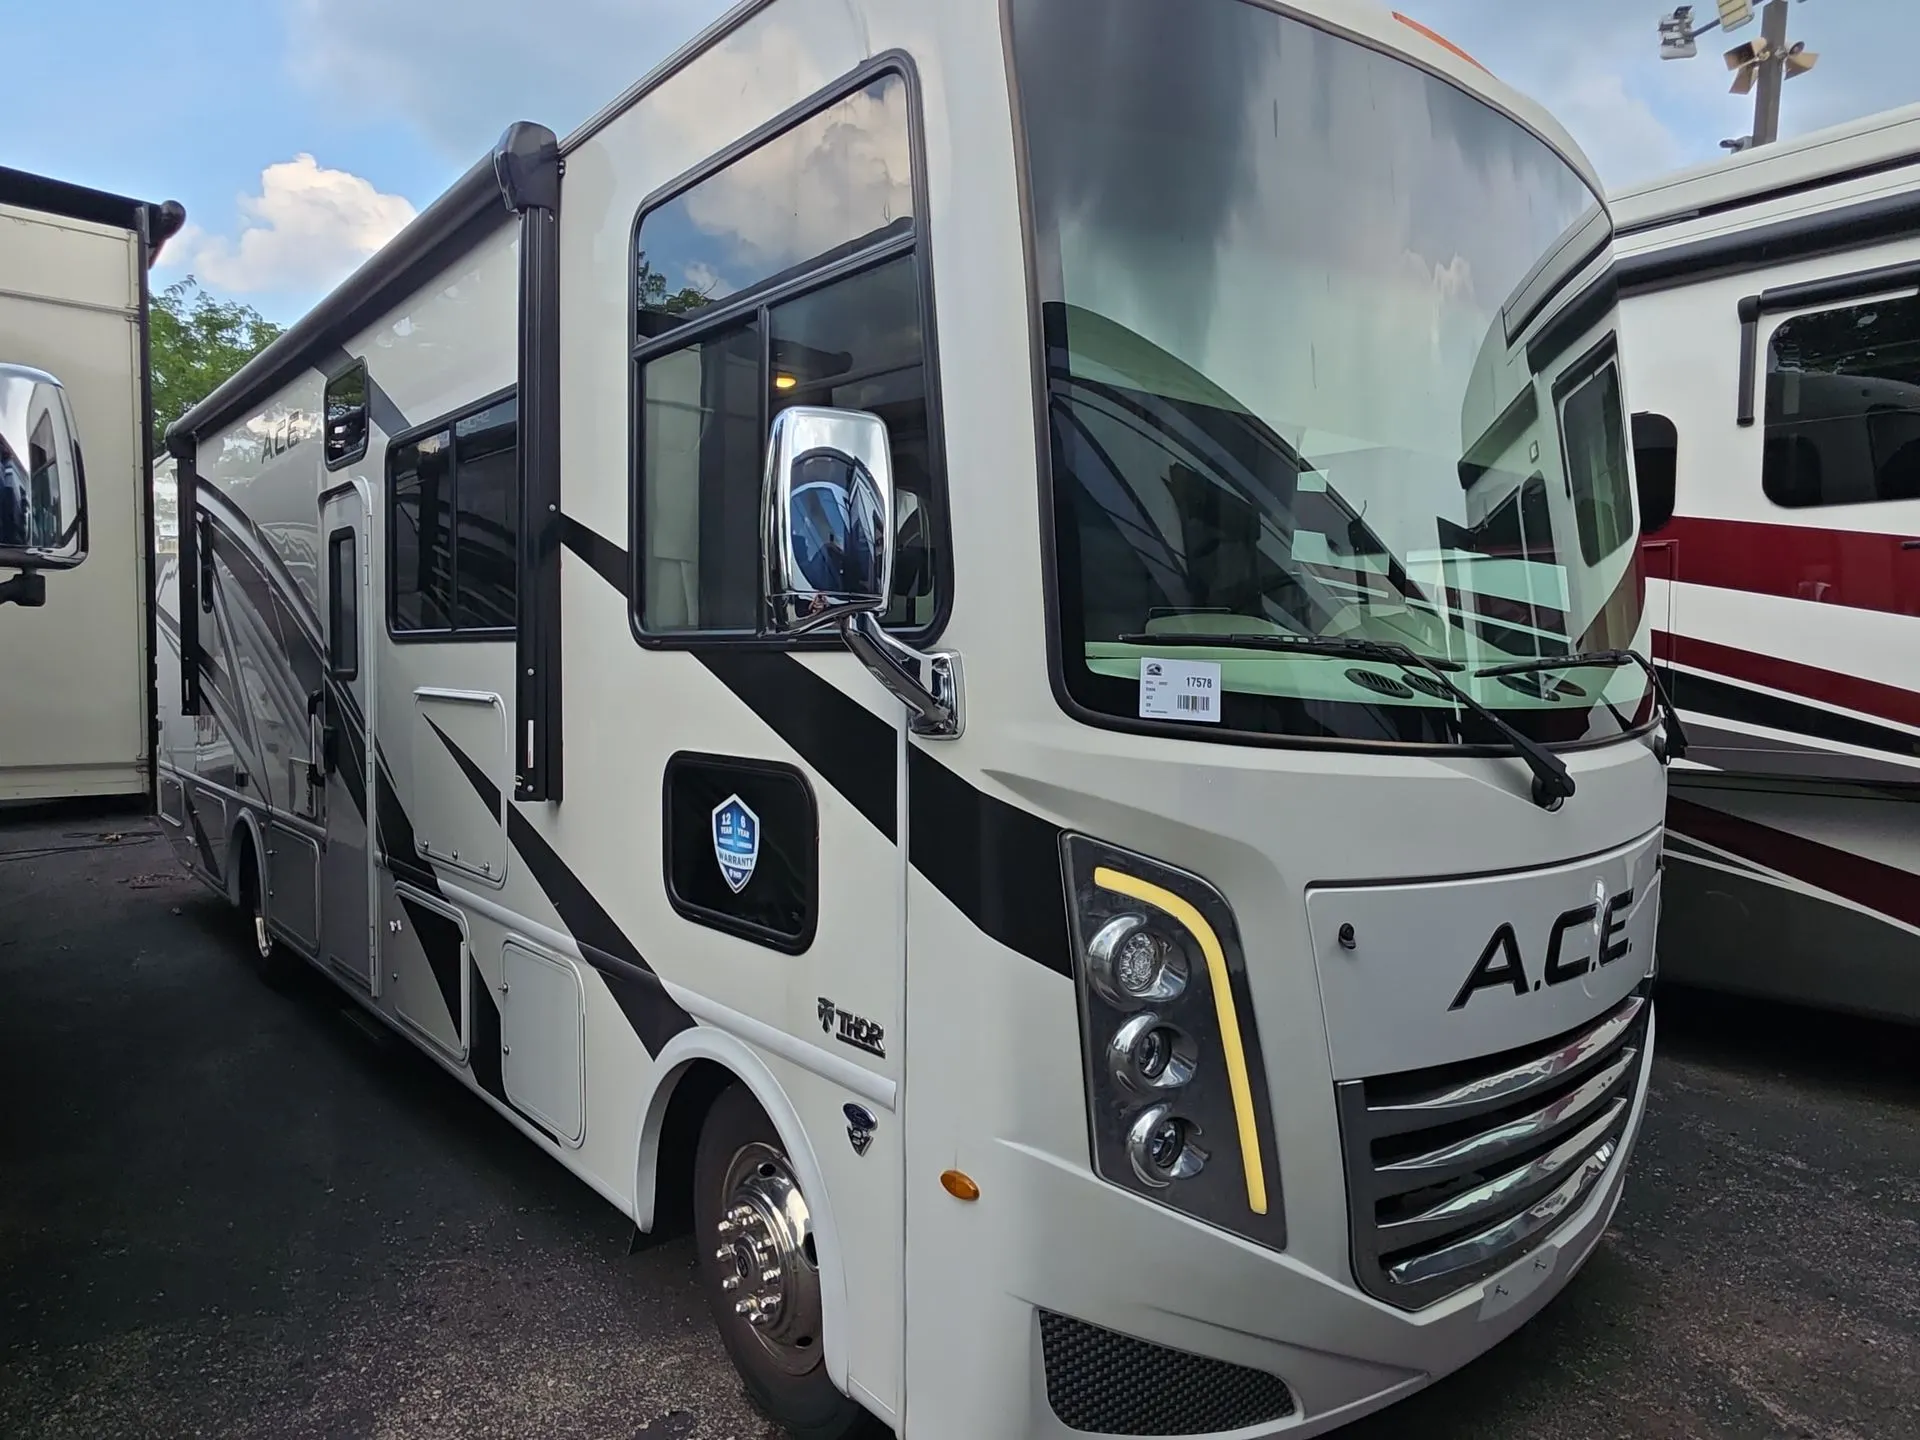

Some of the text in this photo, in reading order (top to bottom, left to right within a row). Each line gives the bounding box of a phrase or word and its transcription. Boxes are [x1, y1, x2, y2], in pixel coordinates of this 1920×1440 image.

[1186, 677, 1212, 689] 17578
[722, 812, 731, 825] 12
[719, 852, 754, 868] WARRANTY
[1447, 888, 1634, 1012] A.C.E.
[836, 1009, 885, 1050] THOR
